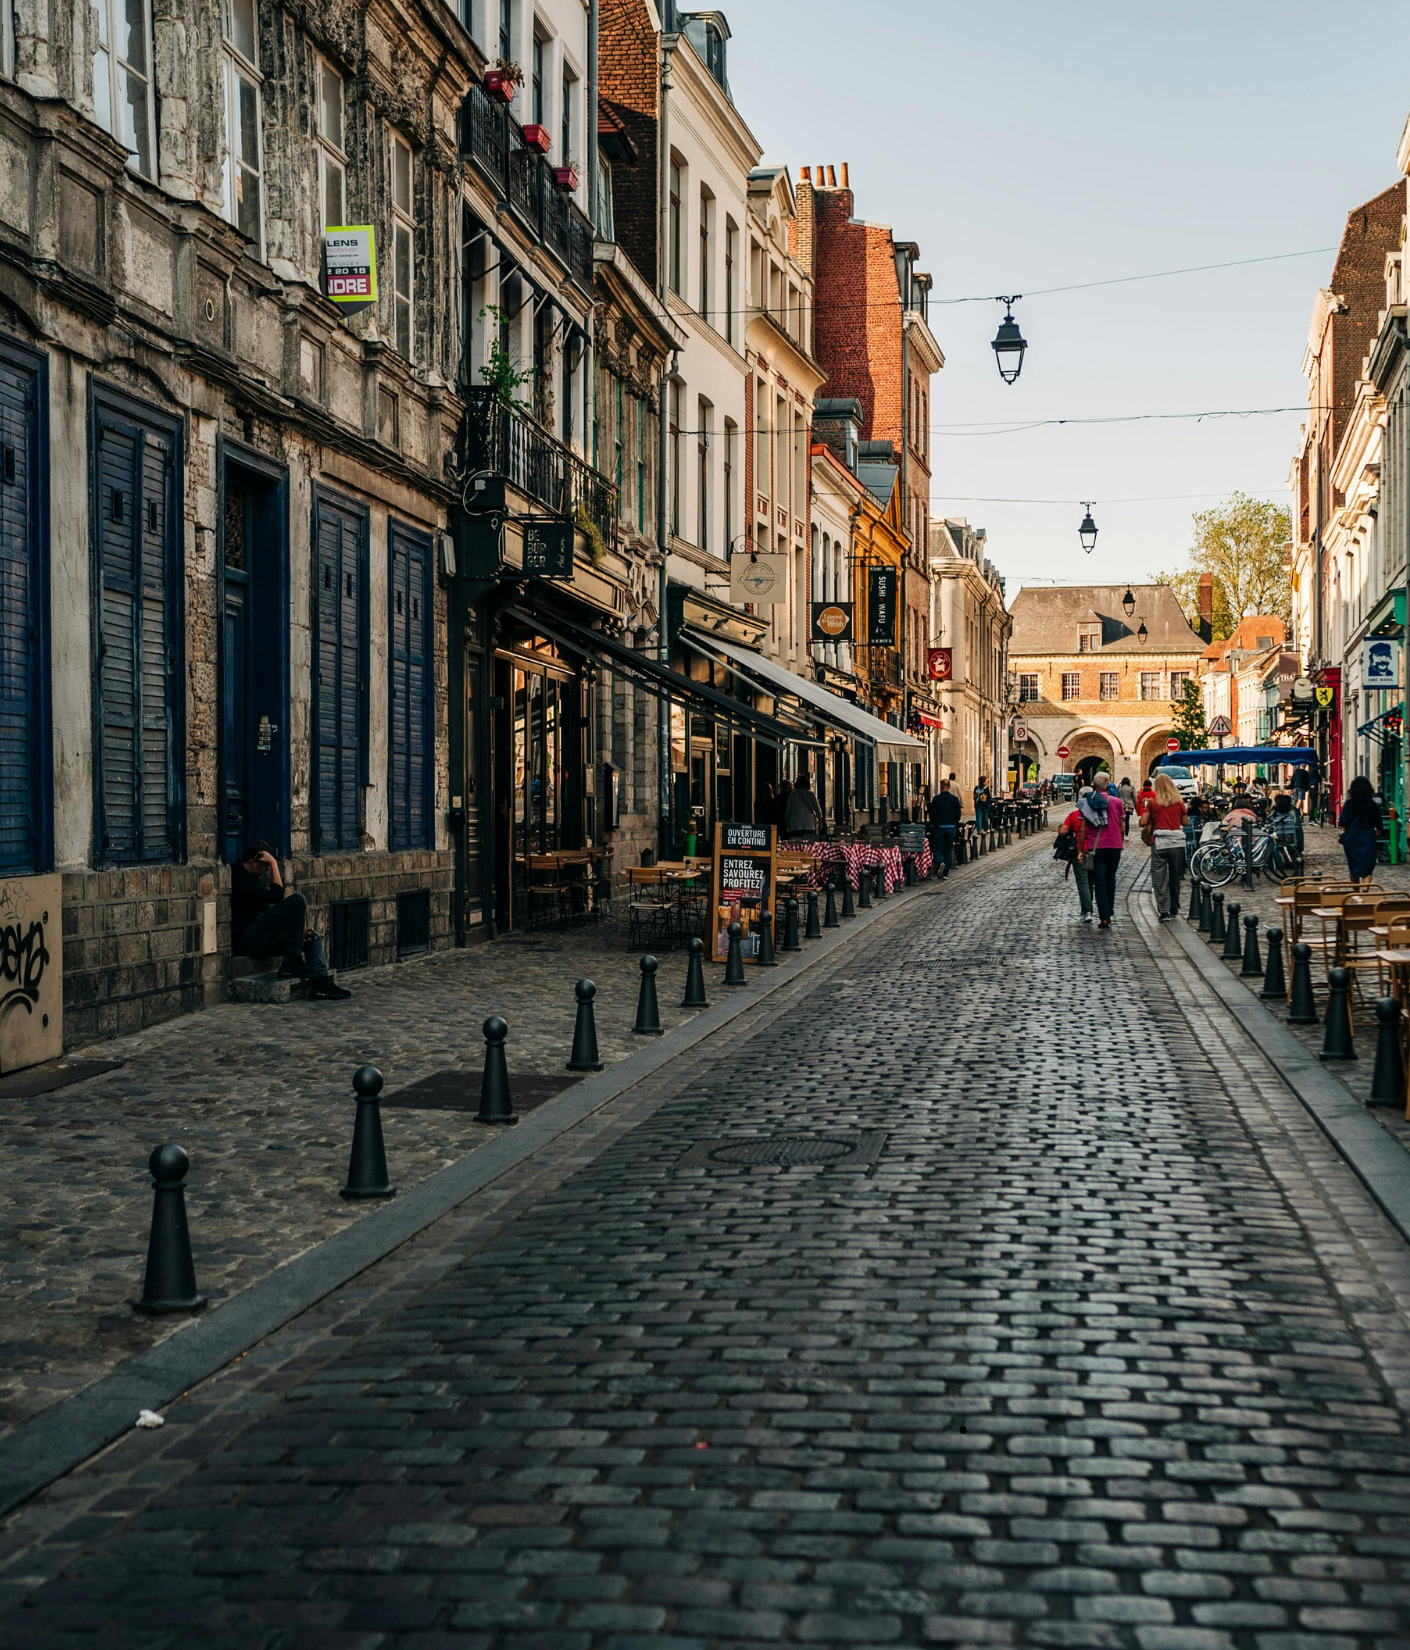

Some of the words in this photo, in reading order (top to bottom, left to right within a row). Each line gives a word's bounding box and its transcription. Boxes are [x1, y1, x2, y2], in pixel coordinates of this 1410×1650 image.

[527, 529, 540, 542] BE
[527, 542, 547, 555] BUR
[527, 555, 546, 568] GER
[878, 576, 886, 597] SUSHI
[878, 603, 886, 624] WAFU
[727, 829, 766, 838] OUVERTURE
[727, 836, 737, 845] EN
[737, 837, 766, 846] CONTINU
[723, 859, 753, 870] ENTREZ
[723, 869, 764, 880] SAVOUREZ
[723, 878, 761, 889] PROFITEZ
